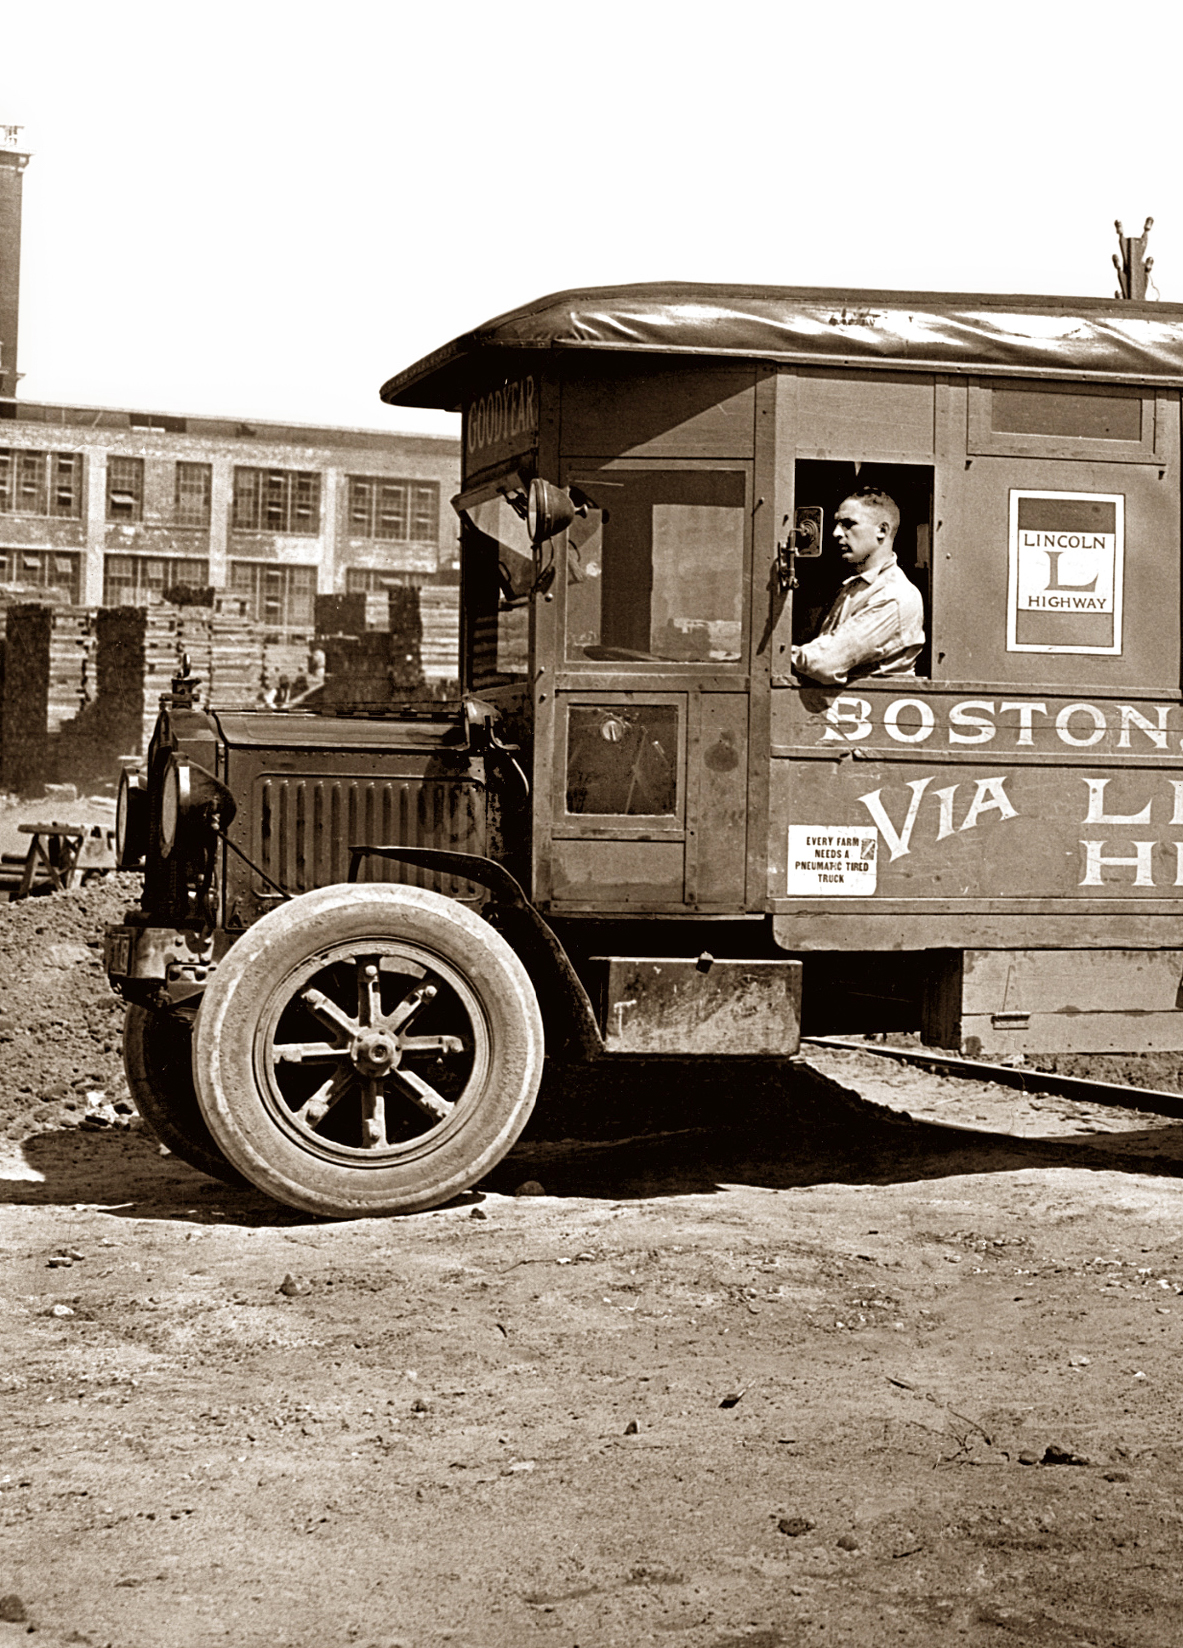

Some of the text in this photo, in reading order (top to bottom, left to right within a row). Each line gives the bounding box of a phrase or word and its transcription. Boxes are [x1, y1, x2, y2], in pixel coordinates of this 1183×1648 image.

[468, 375, 535, 453] GOODYEAR
[1024, 533, 1106, 549] LINCOLN
[1043, 551, 1099, 592] L
[1028, 596, 1106, 609] HIGHWAY
[806, 837, 859, 846] EVERY FARM
[815, 849, 850, 858] NEEDS A
[846, 862, 869, 872] TIRED
[818, 874, 844, 883] TRUCK
